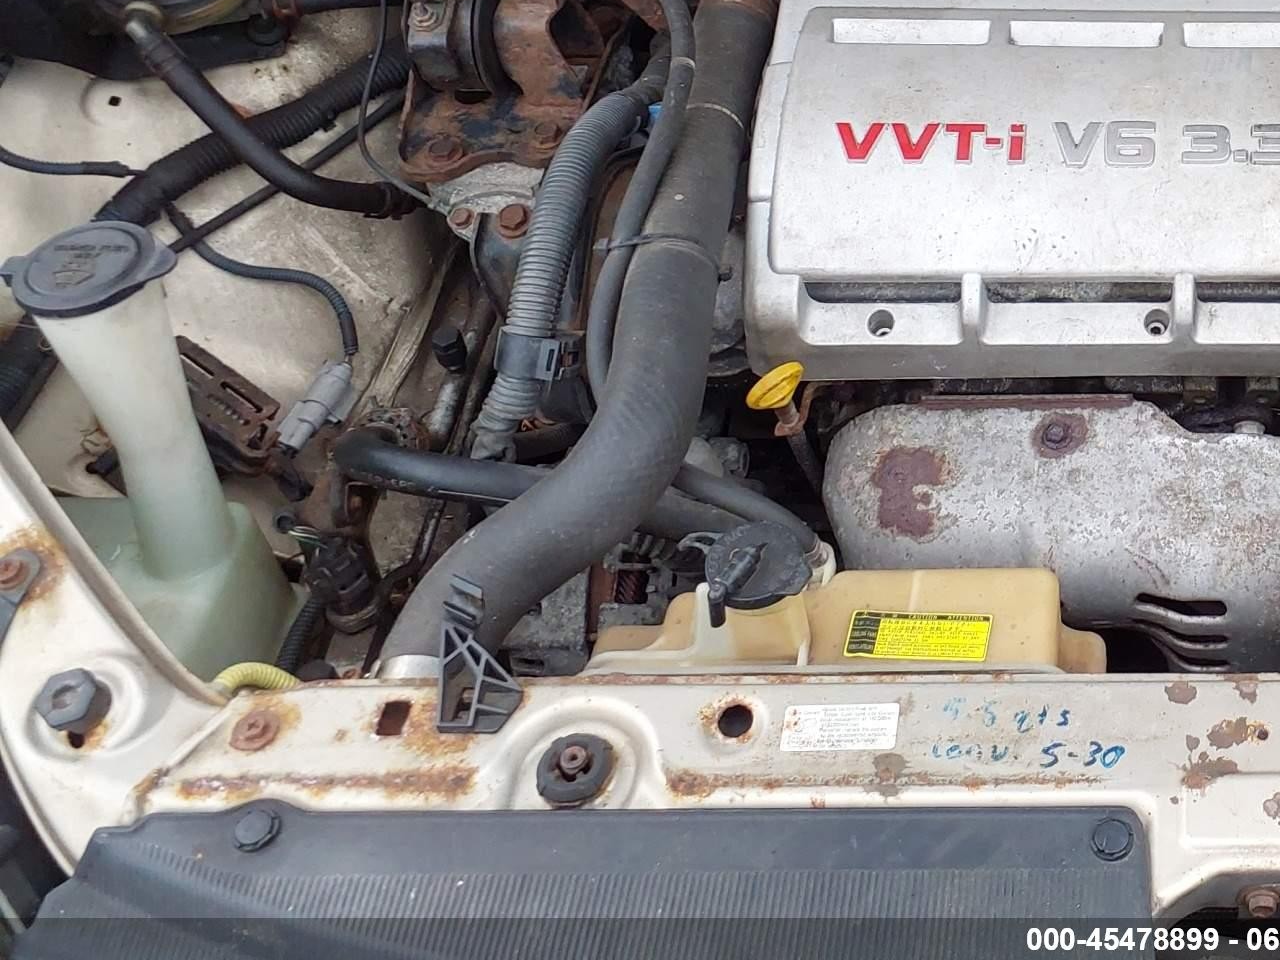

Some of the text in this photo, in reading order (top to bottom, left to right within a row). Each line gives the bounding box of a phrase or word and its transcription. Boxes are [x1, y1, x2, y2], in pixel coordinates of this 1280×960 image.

[835, 122, 1027, 165] VVT-i
[1052, 121, 1157, 168] V6
[1040, 741, 1126, 768] 5-30
